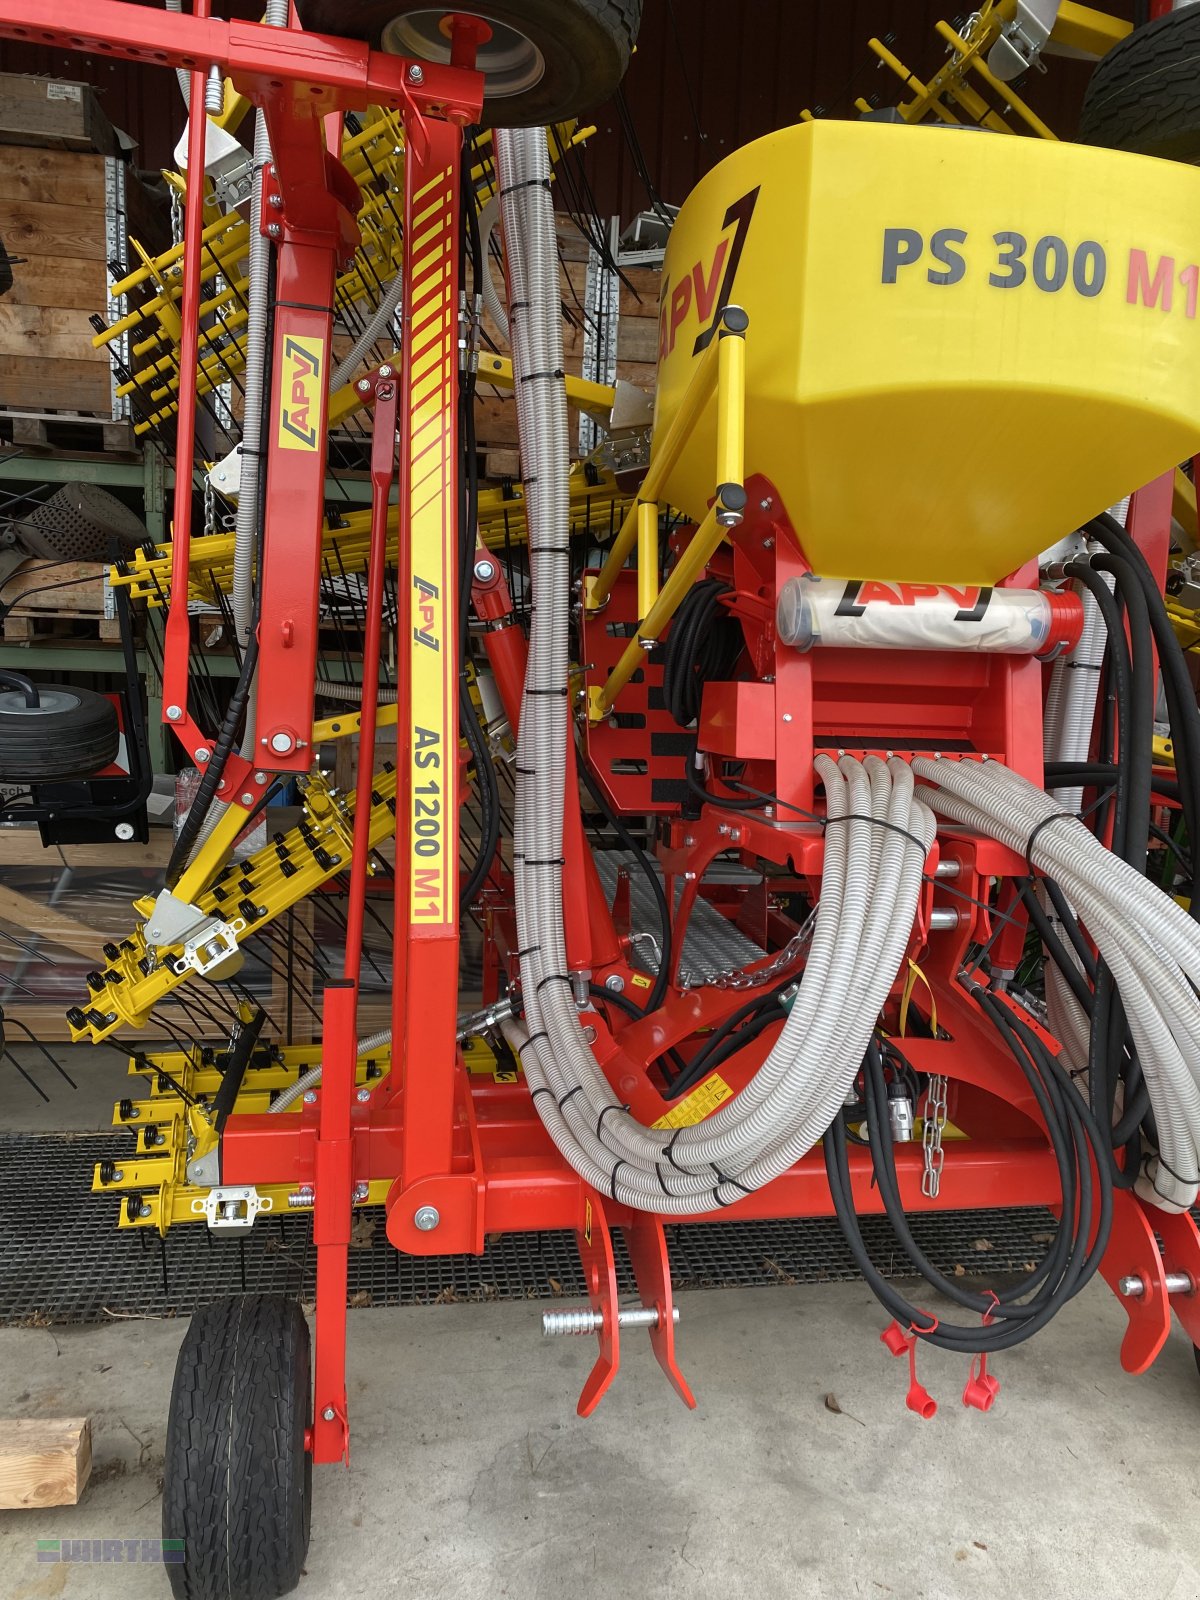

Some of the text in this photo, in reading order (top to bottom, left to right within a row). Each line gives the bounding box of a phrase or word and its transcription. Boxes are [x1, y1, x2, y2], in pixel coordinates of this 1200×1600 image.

[658, 233, 733, 362] APV
[881, 228, 1199, 319] PS 300 M1
[287, 350, 314, 436] APV
[416, 583, 437, 645] APV
[855, 580, 983, 609] APV
[414, 726, 440, 917] AS 1200 M1
